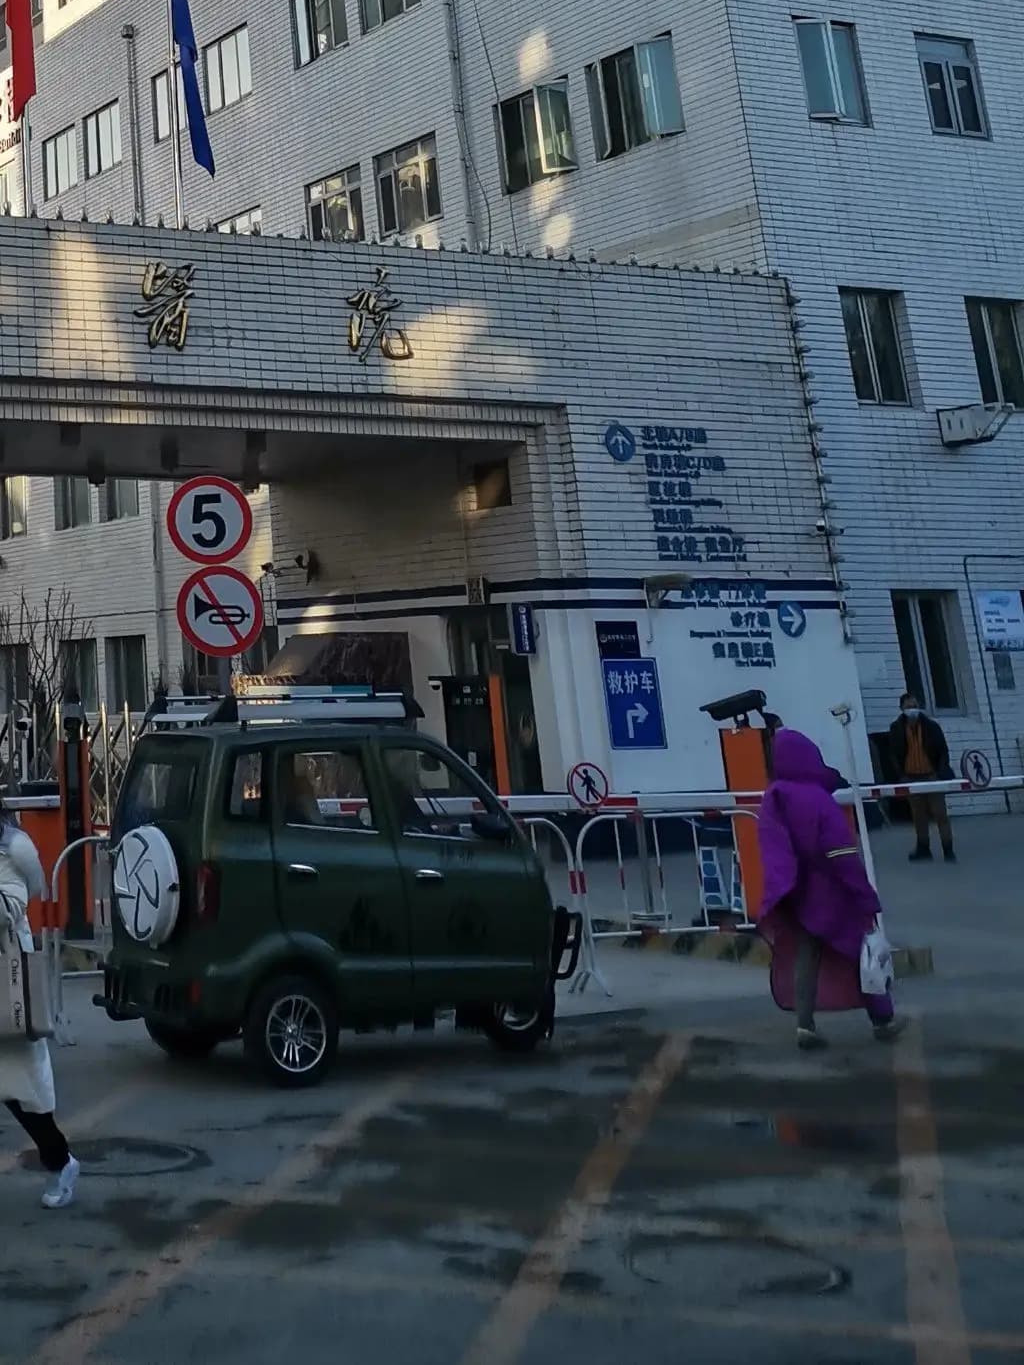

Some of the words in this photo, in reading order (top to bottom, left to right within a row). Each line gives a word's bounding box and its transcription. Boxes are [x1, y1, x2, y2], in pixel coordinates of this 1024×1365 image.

[191, 493, 226, 548] 5
[607, 670, 654, 695] 救护车
